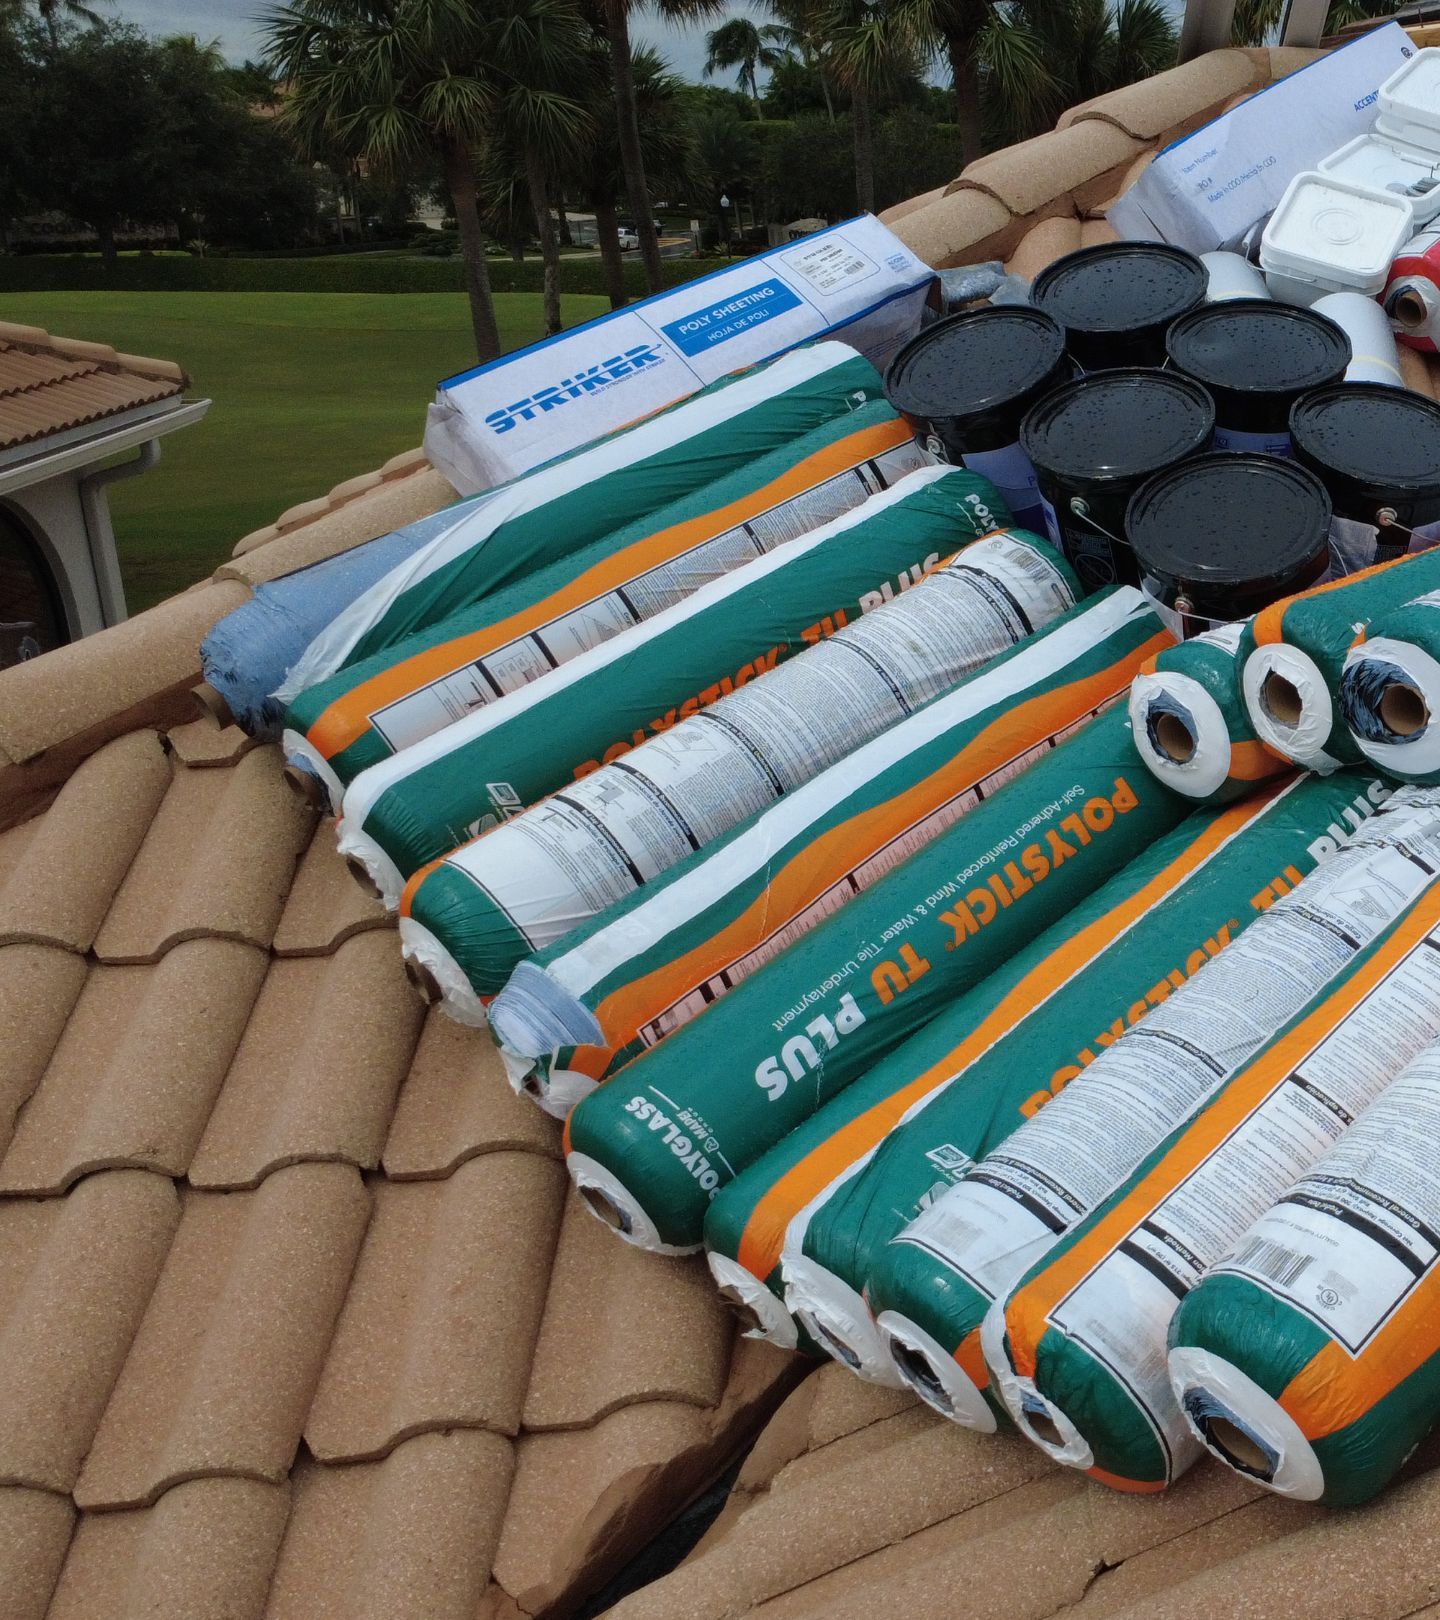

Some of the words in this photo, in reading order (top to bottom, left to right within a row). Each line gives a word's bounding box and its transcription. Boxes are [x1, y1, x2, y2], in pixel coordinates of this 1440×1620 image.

[678, 314, 712, 335] POLY
[712, 287, 775, 319] SHEETING
[708, 326, 736, 342] HOJA
[734, 319, 748, 329] DE
[749, 309, 769, 323] POLI
[485, 343, 662, 434] STRIKER
[1013, 781, 1085, 840] Self-Adhered
[938, 777, 1140, 946] POLYSTICK
[954, 833, 1019, 886] Reinforced
[912, 902, 928, 918] &
[924, 878, 960, 909] Wind
[878, 910, 918, 945] Water
[854, 938, 884, 965] Tile
[870, 941, 931, 1006] TU
[773, 956, 860, 1033] Underlayment
[755, 992, 867, 1101] PLUS
[1302, 1082, 1341, 1112] aplicación
[624, 1096, 721, 1200] OLYGLASS
[1375, 1217, 1404, 1239] Coverage
[1386, 1202, 1422, 1229] General
[1160, 1232, 1195, 1263] Methods
